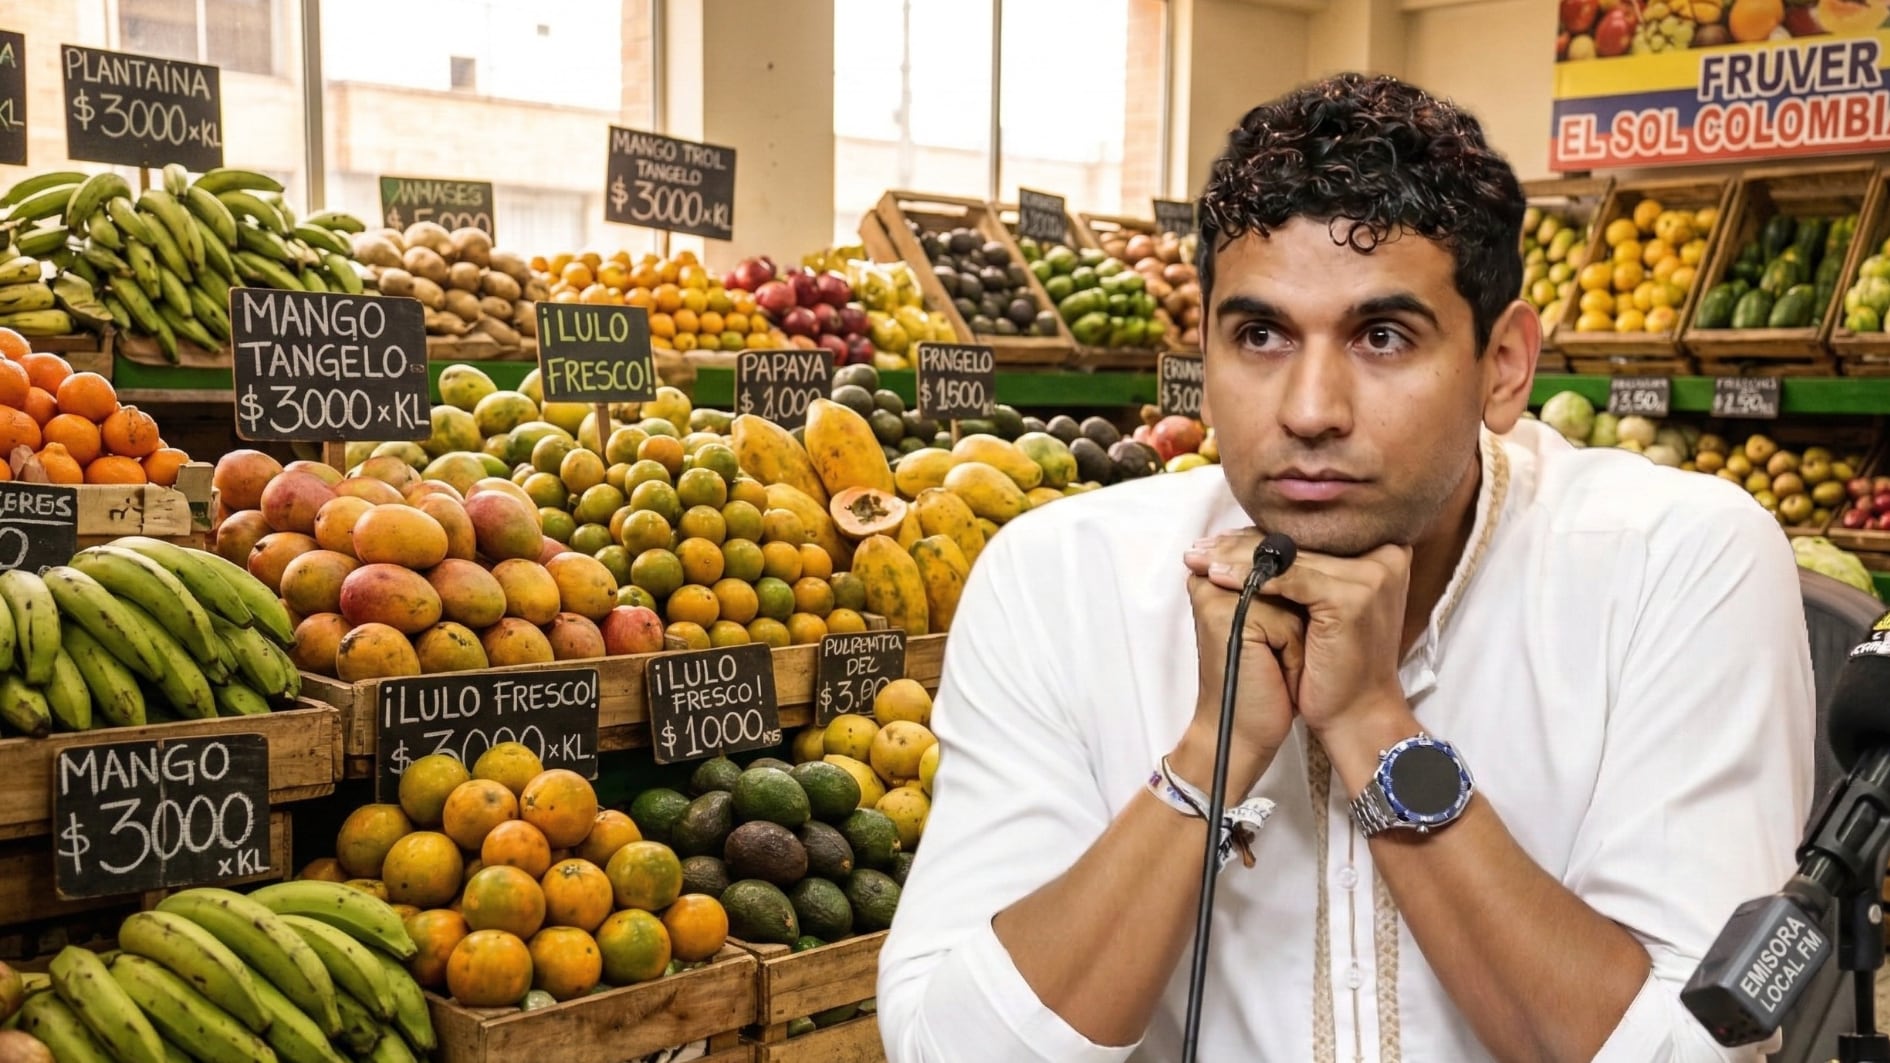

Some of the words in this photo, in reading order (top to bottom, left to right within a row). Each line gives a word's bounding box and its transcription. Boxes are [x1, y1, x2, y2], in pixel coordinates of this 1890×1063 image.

[1701, 41, 1880, 96] FRUVER
[612, 129, 677, 161] MANGO
[1560, 115, 1601, 157] EL
[1611, 109, 1685, 157] SOL
[1698, 92, 1890, 149] COLOMBI
[243, 292, 386, 341] MANGO
[238, 341, 408, 381] TANGELO
[547, 357, 653, 395] FRESCO!
[741, 353, 827, 383] PAPAYA
[493, 672, 597, 715] FRESCO!
[61, 742, 230, 795] MANGO
[1740, 917, 1806, 998] EMISORA
[1760, 959, 1805, 1013] LOCAL
[1796, 929, 1823, 960] FM
